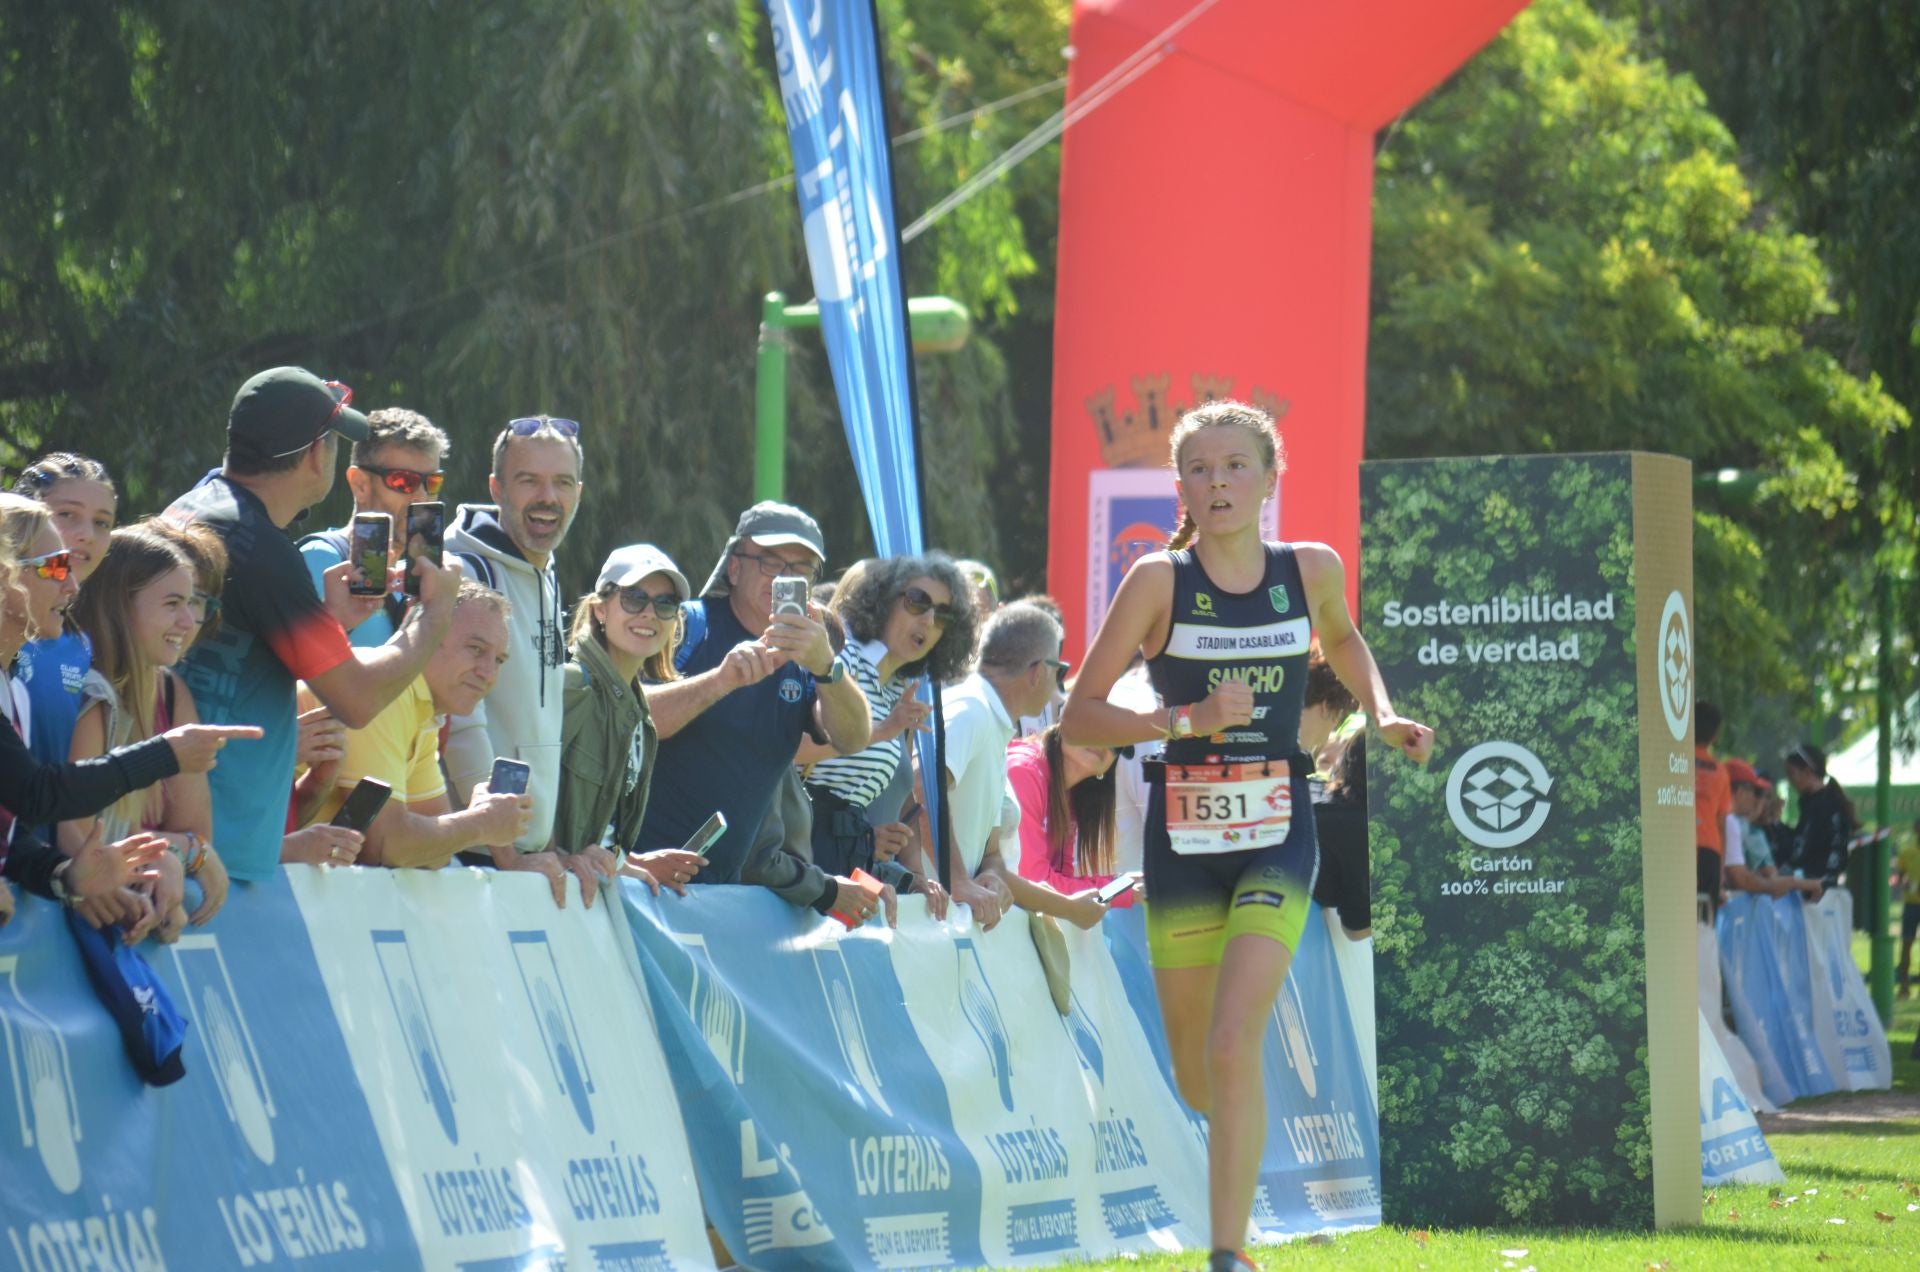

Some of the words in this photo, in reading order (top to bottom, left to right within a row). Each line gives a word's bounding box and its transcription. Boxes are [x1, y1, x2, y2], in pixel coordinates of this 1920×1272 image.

[1383, 592, 1615, 628] Sostenibilidad
[1196, 635, 1237, 650] STADIUM
[1239, 631, 1297, 650] CASABLANCA
[1418, 638, 1459, 666] de
[1466, 634, 1580, 664] verdad
[1207, 665, 1284, 694] SANCHO
[1178, 794, 1248, 821] 1531
[1470, 856, 1533, 874] Cartón
[1441, 879, 1489, 896] 100%
[1492, 878, 1565, 896] circular
[984, 1114, 1069, 1184] LOTERÍAS
[1282, 1100, 1365, 1165] LOTERÍAS
[849, 1122, 951, 1196] LOTERÍAS
[422, 1151, 534, 1237] LOTERÍAS
[561, 1139, 661, 1221] LOTERÍAS
[216, 1165, 368, 1268] LOTERÍAS
